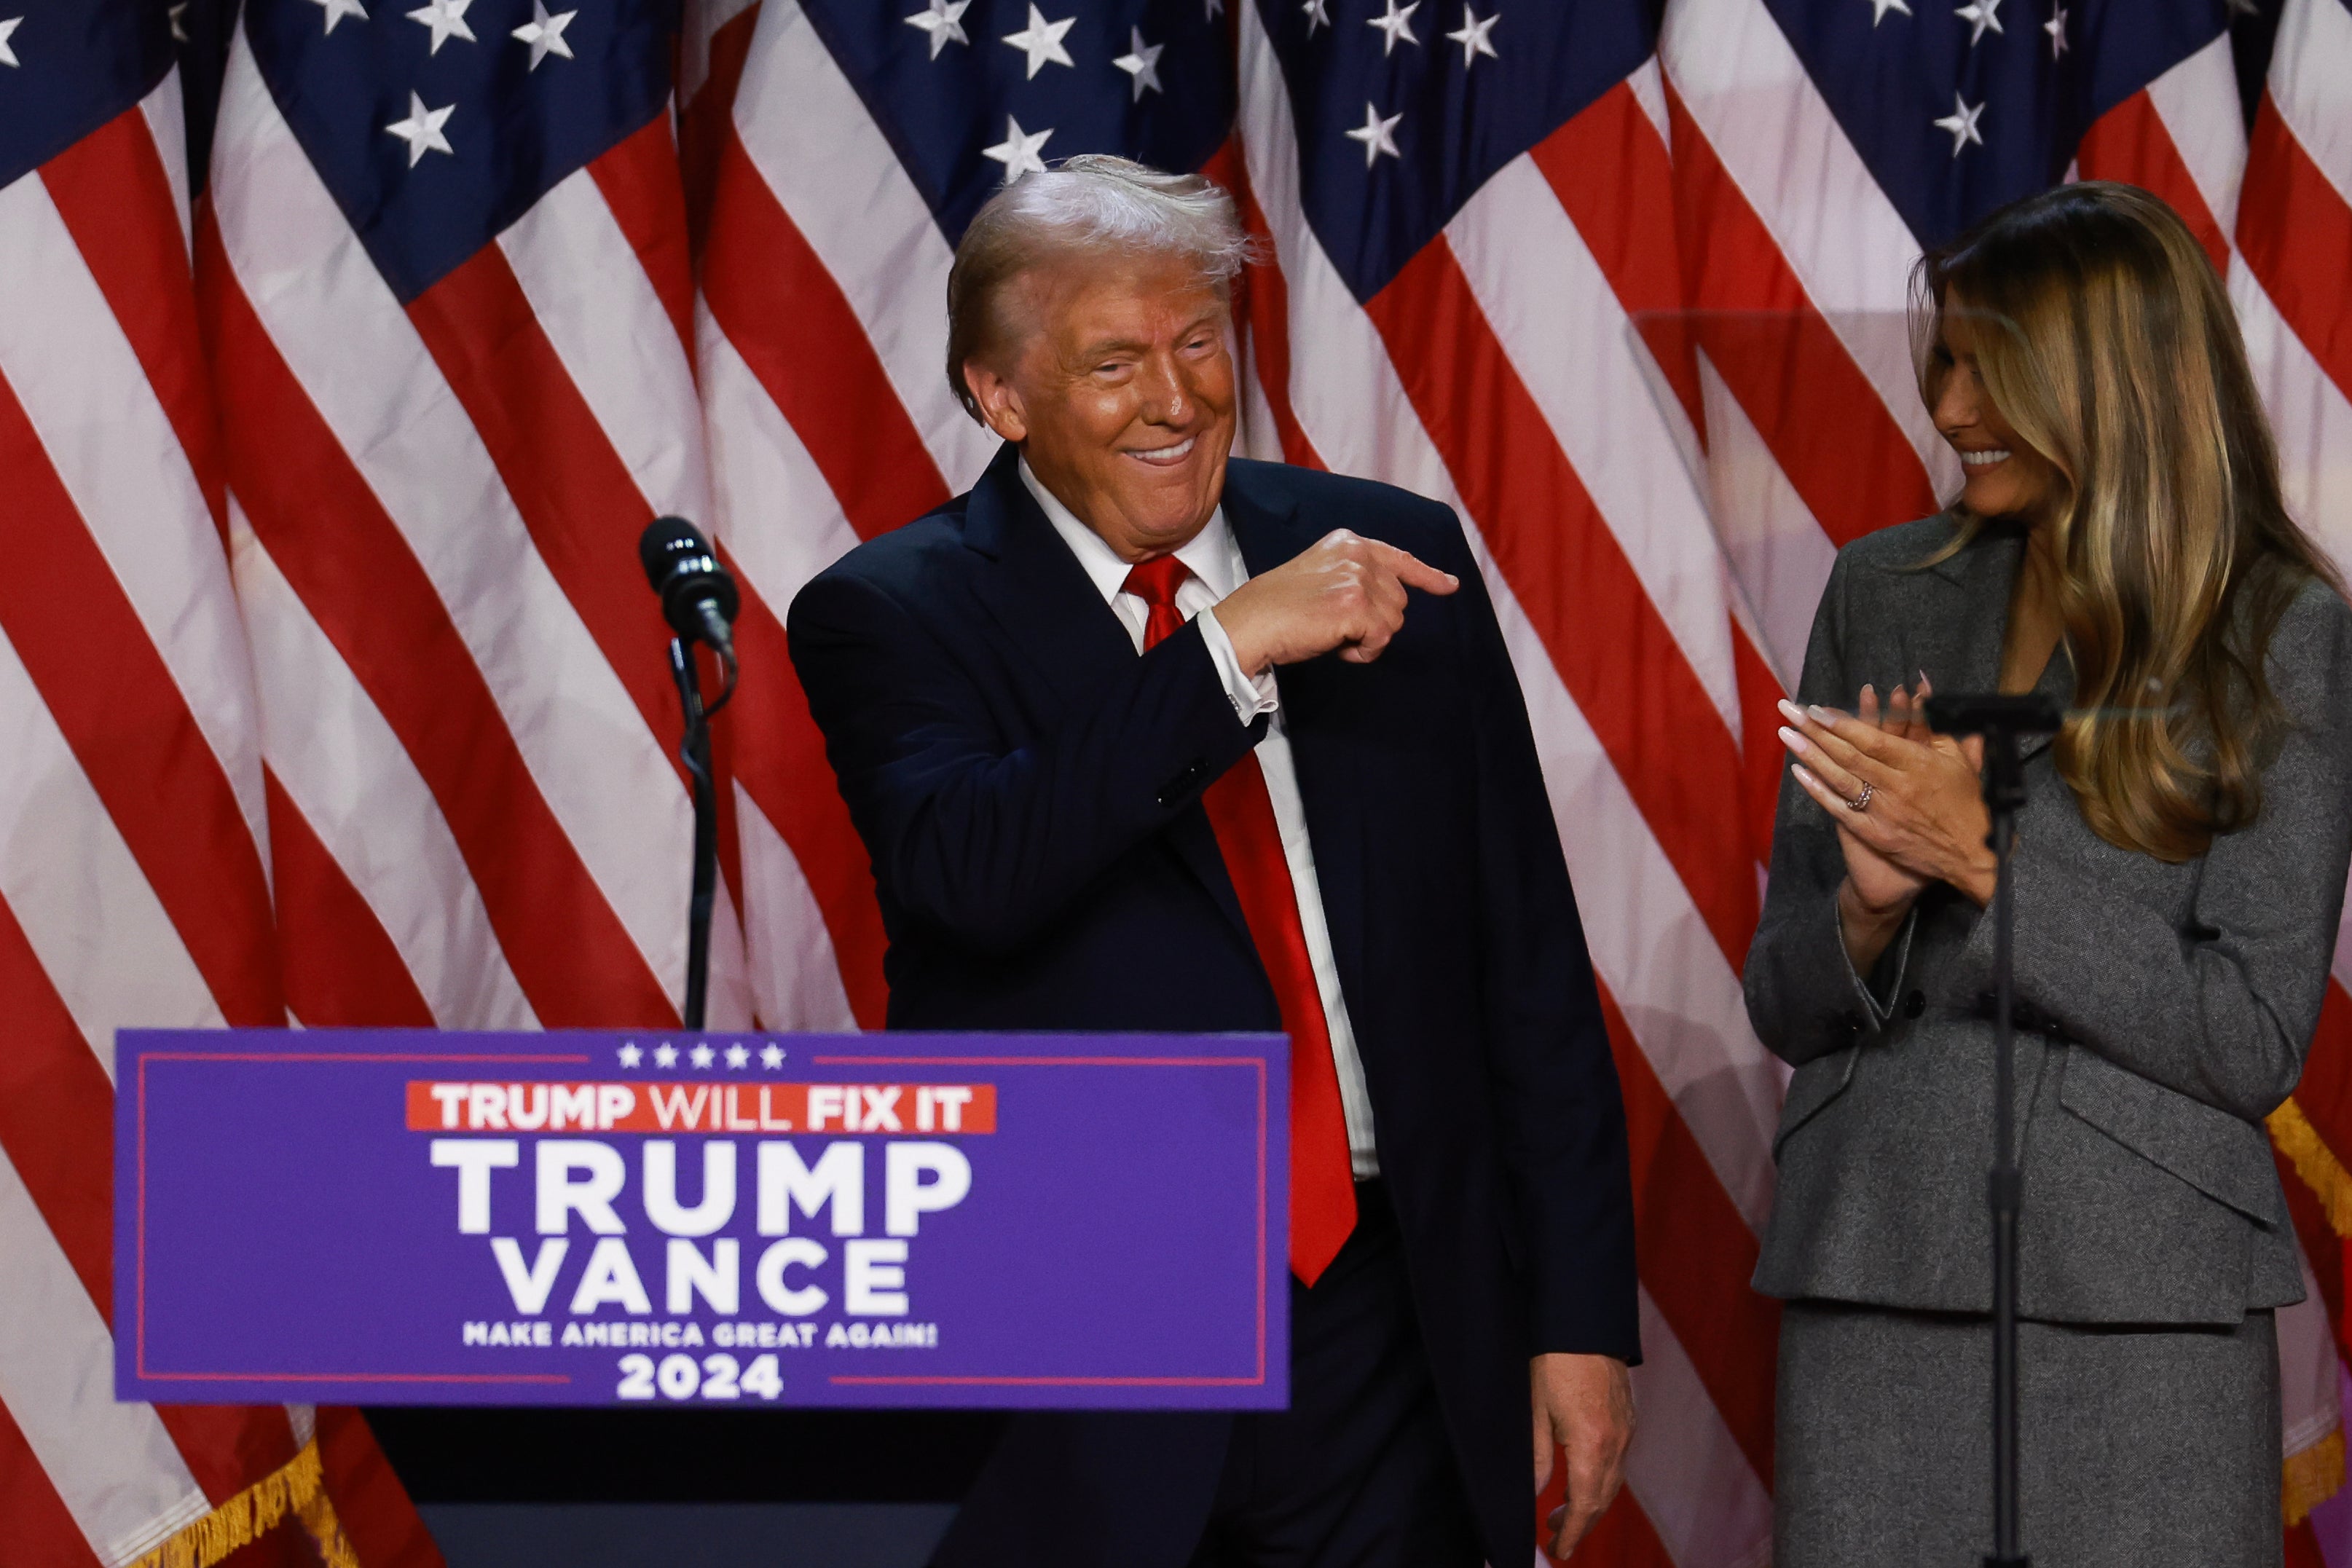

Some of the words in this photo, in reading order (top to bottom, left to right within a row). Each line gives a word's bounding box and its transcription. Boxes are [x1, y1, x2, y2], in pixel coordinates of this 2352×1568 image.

[431, 1082, 637, 1131] TRUMP
[648, 1084, 793, 1132] WILL
[806, 1084, 903, 1132] FIX
[915, 1085, 973, 1132] IT
[430, 1138, 972, 1237] TRUMP
[490, 1237, 910, 1317] VANCE
[463, 1321, 553, 1347] MAKE
[561, 1322, 704, 1347] AMERICA
[712, 1322, 818, 1348] GREAT
[825, 1323, 937, 1348] AGAIN!
[617, 1353, 784, 1400] 2024
